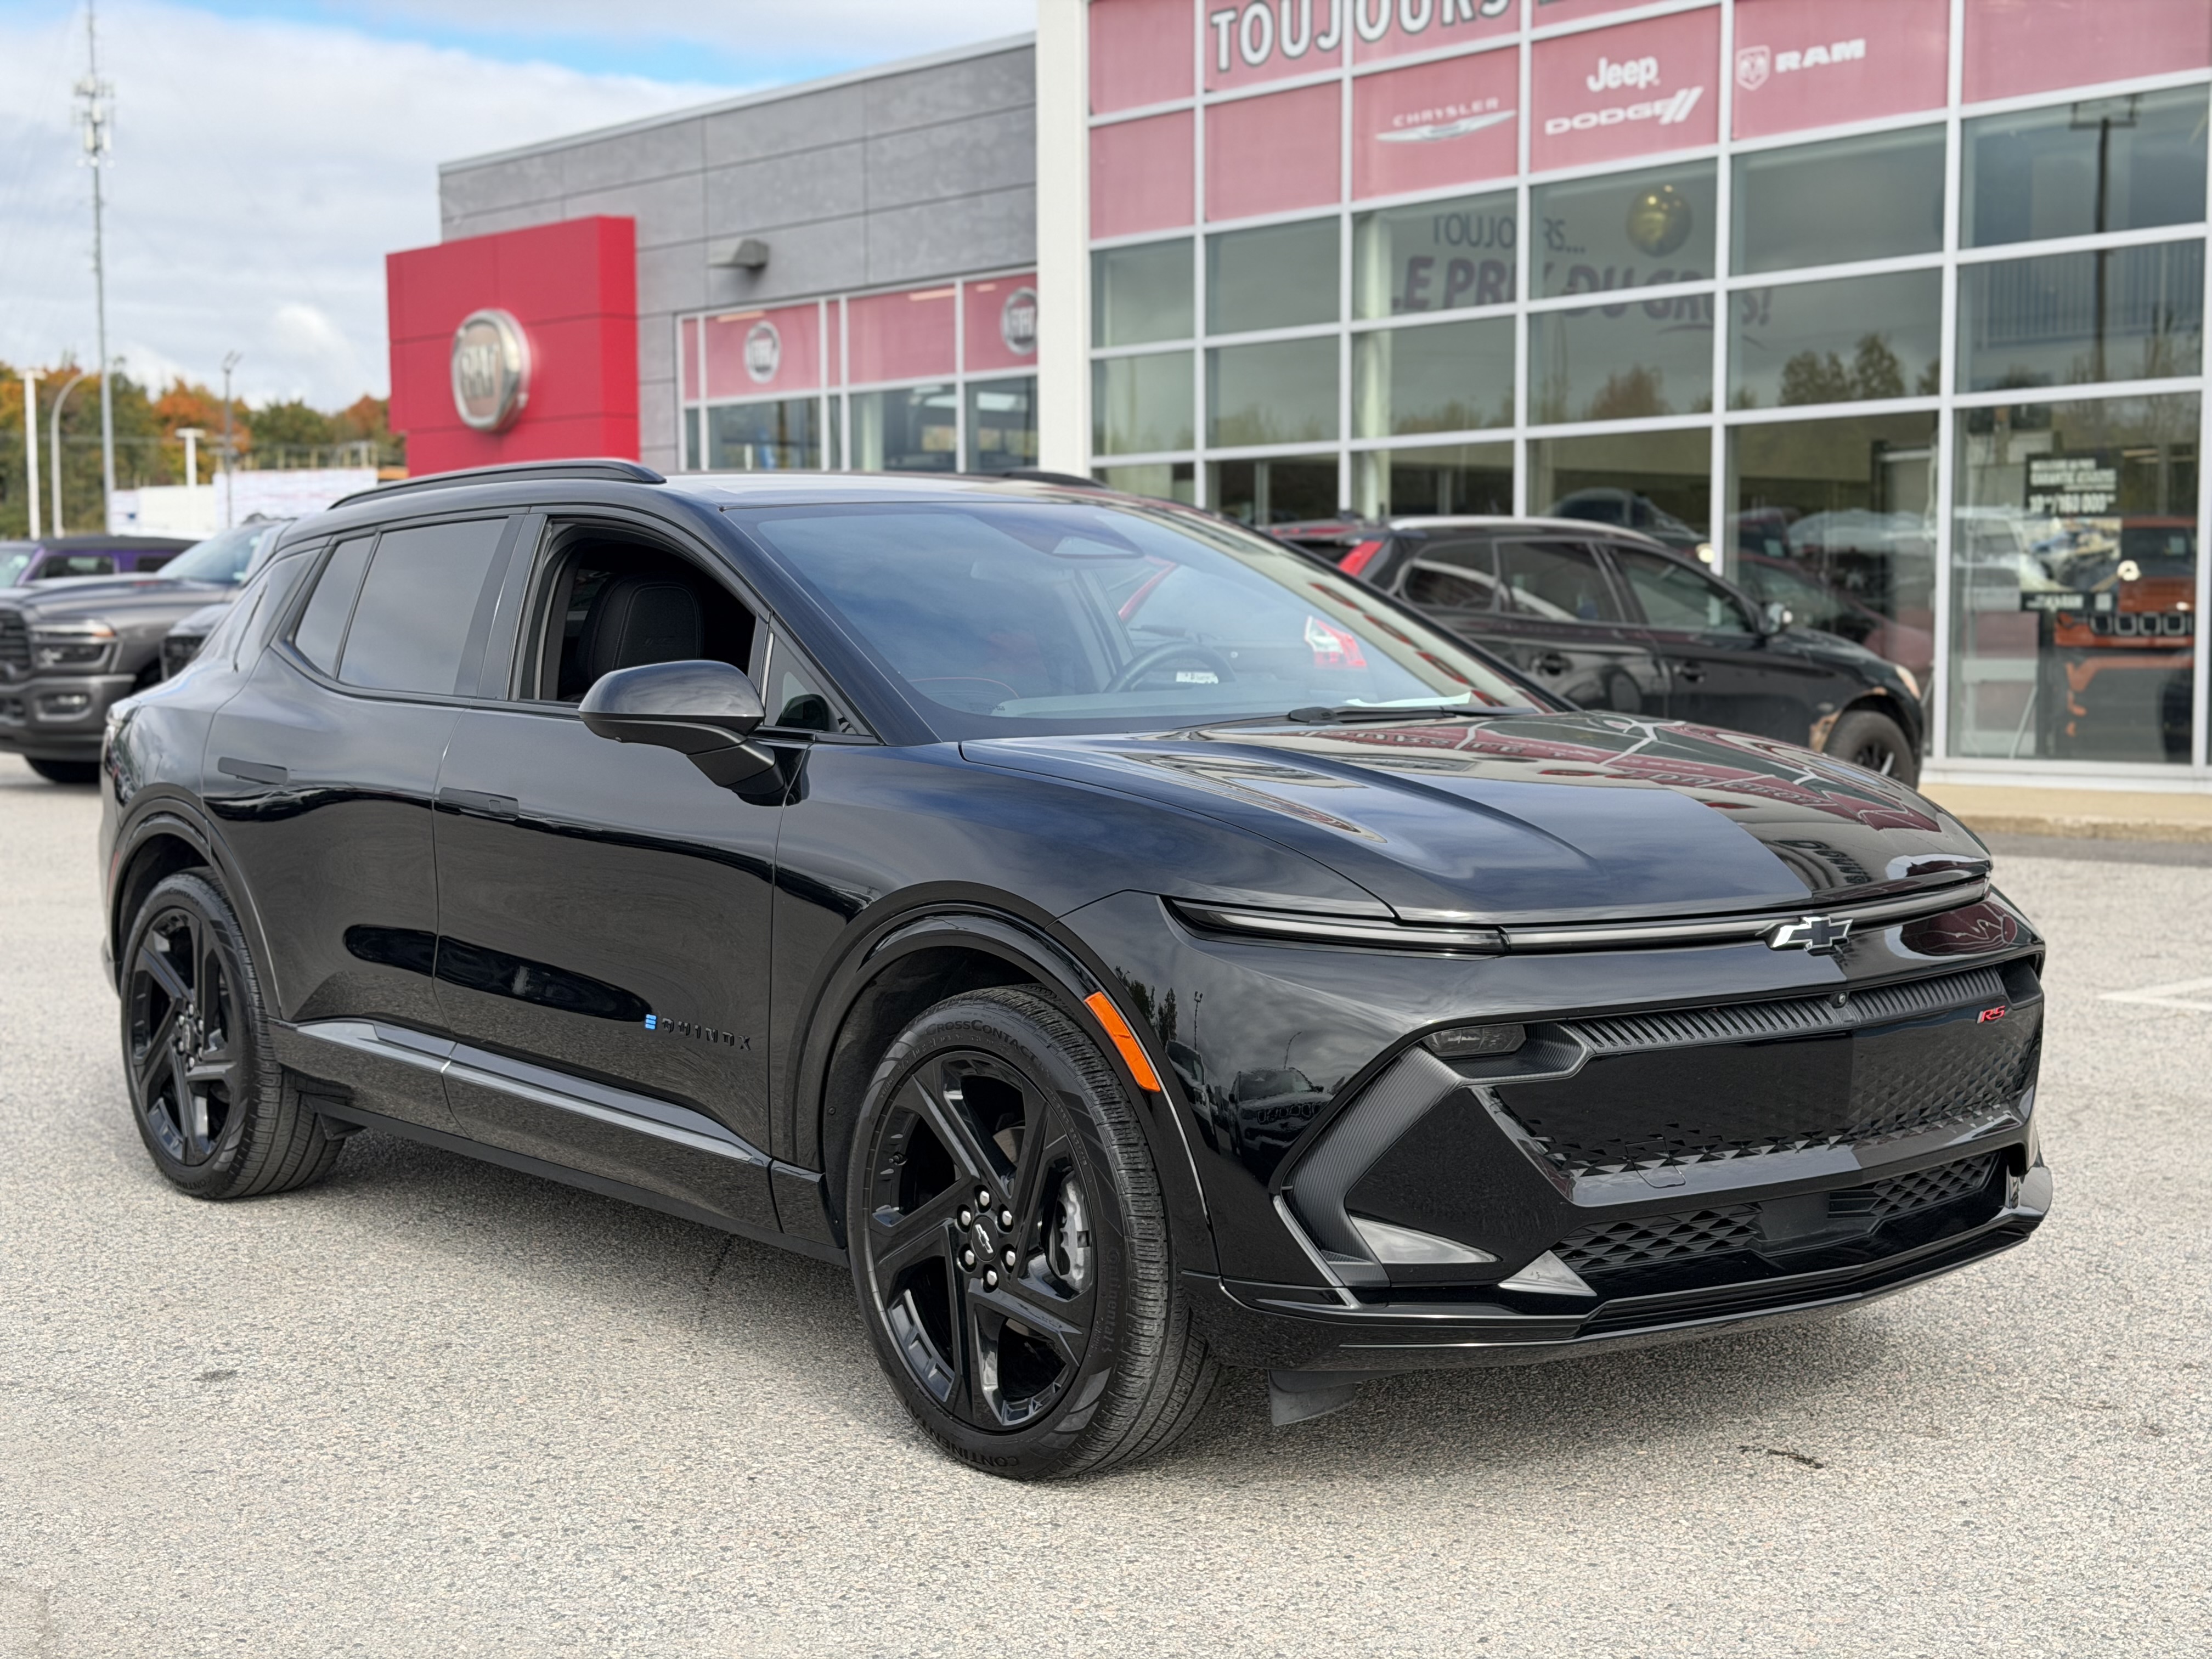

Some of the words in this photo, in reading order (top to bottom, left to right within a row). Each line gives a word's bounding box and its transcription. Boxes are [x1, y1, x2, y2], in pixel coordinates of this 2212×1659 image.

[1586, 55, 1658, 92] Jeep
[1775, 43, 1866, 73] RAM
[1392, 97, 1499, 127] CHRYSLER
[1544, 97, 1677, 136] DODGE
[1977, 1005, 2006, 1024] RS
[645, 1014, 751, 1051] EQUINOX
